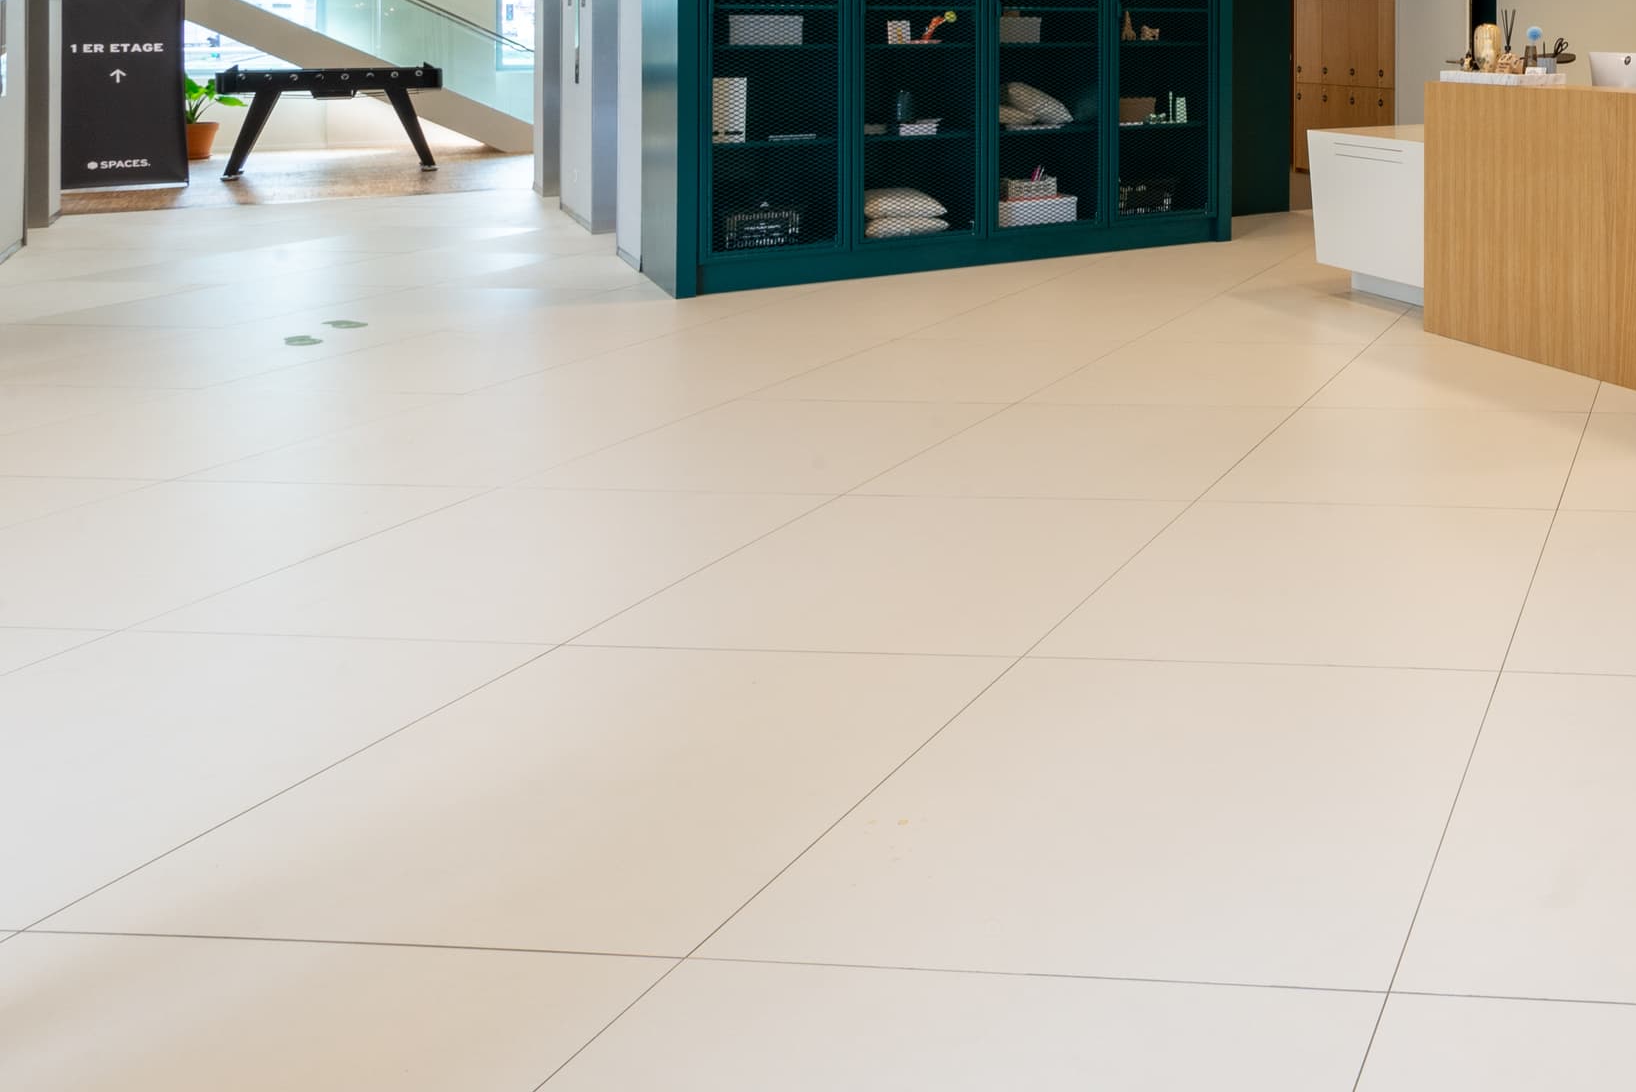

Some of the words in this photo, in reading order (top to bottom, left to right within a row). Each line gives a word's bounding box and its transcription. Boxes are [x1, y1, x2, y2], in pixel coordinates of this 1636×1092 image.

[70, 43, 77, 53] 1
[82, 43, 105, 53] ER
[109, 42, 164, 53] ETAGE
[100, 158, 151, 169] SPACES.
